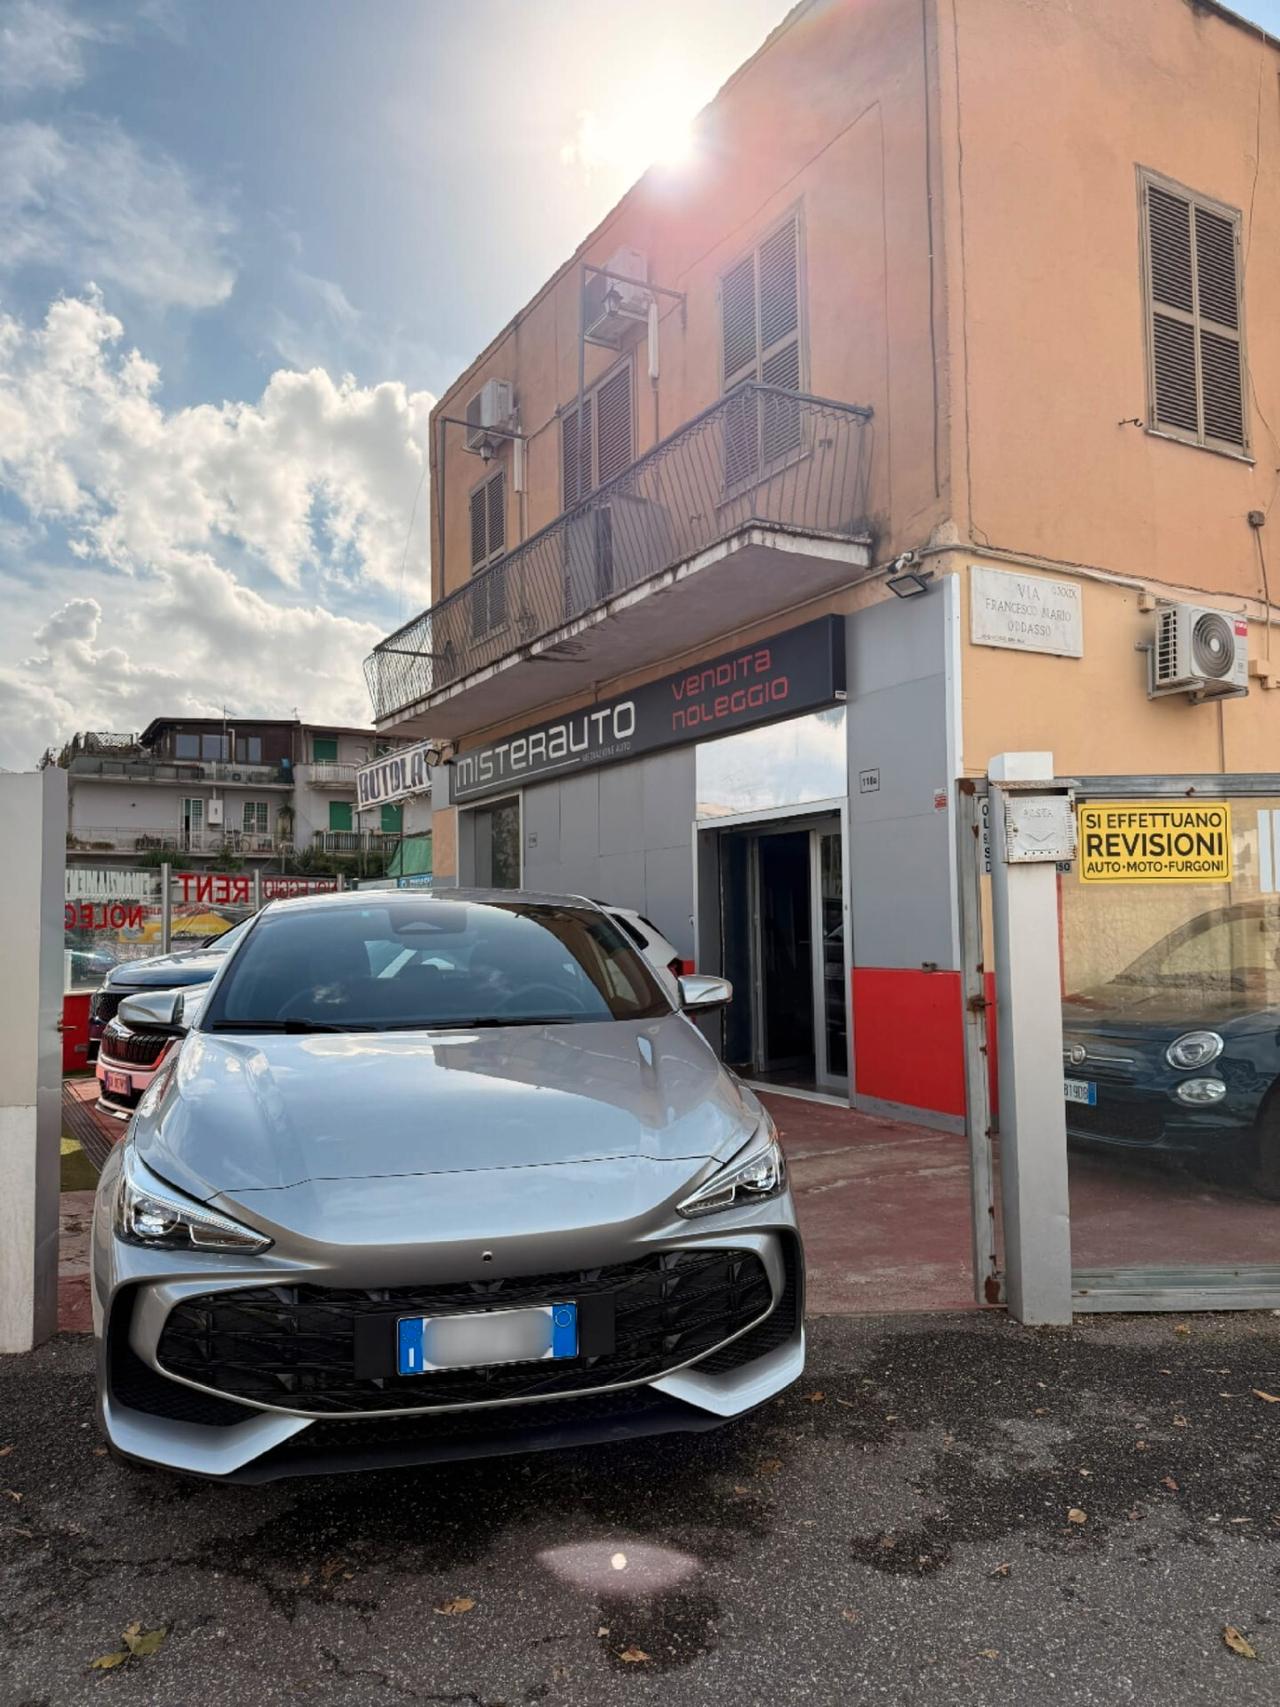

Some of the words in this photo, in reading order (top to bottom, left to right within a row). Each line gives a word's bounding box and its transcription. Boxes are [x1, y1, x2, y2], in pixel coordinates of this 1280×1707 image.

[1017, 583, 1041, 601] VIA
[985, 597, 1038, 617] FRANCESCO
[1041, 607, 1072, 623] MARIO
[1086, 813, 1101, 829] SI
[1107, 812, 1223, 829] EFFETTUANO
[1086, 832, 1223, 857] REVISIONI
